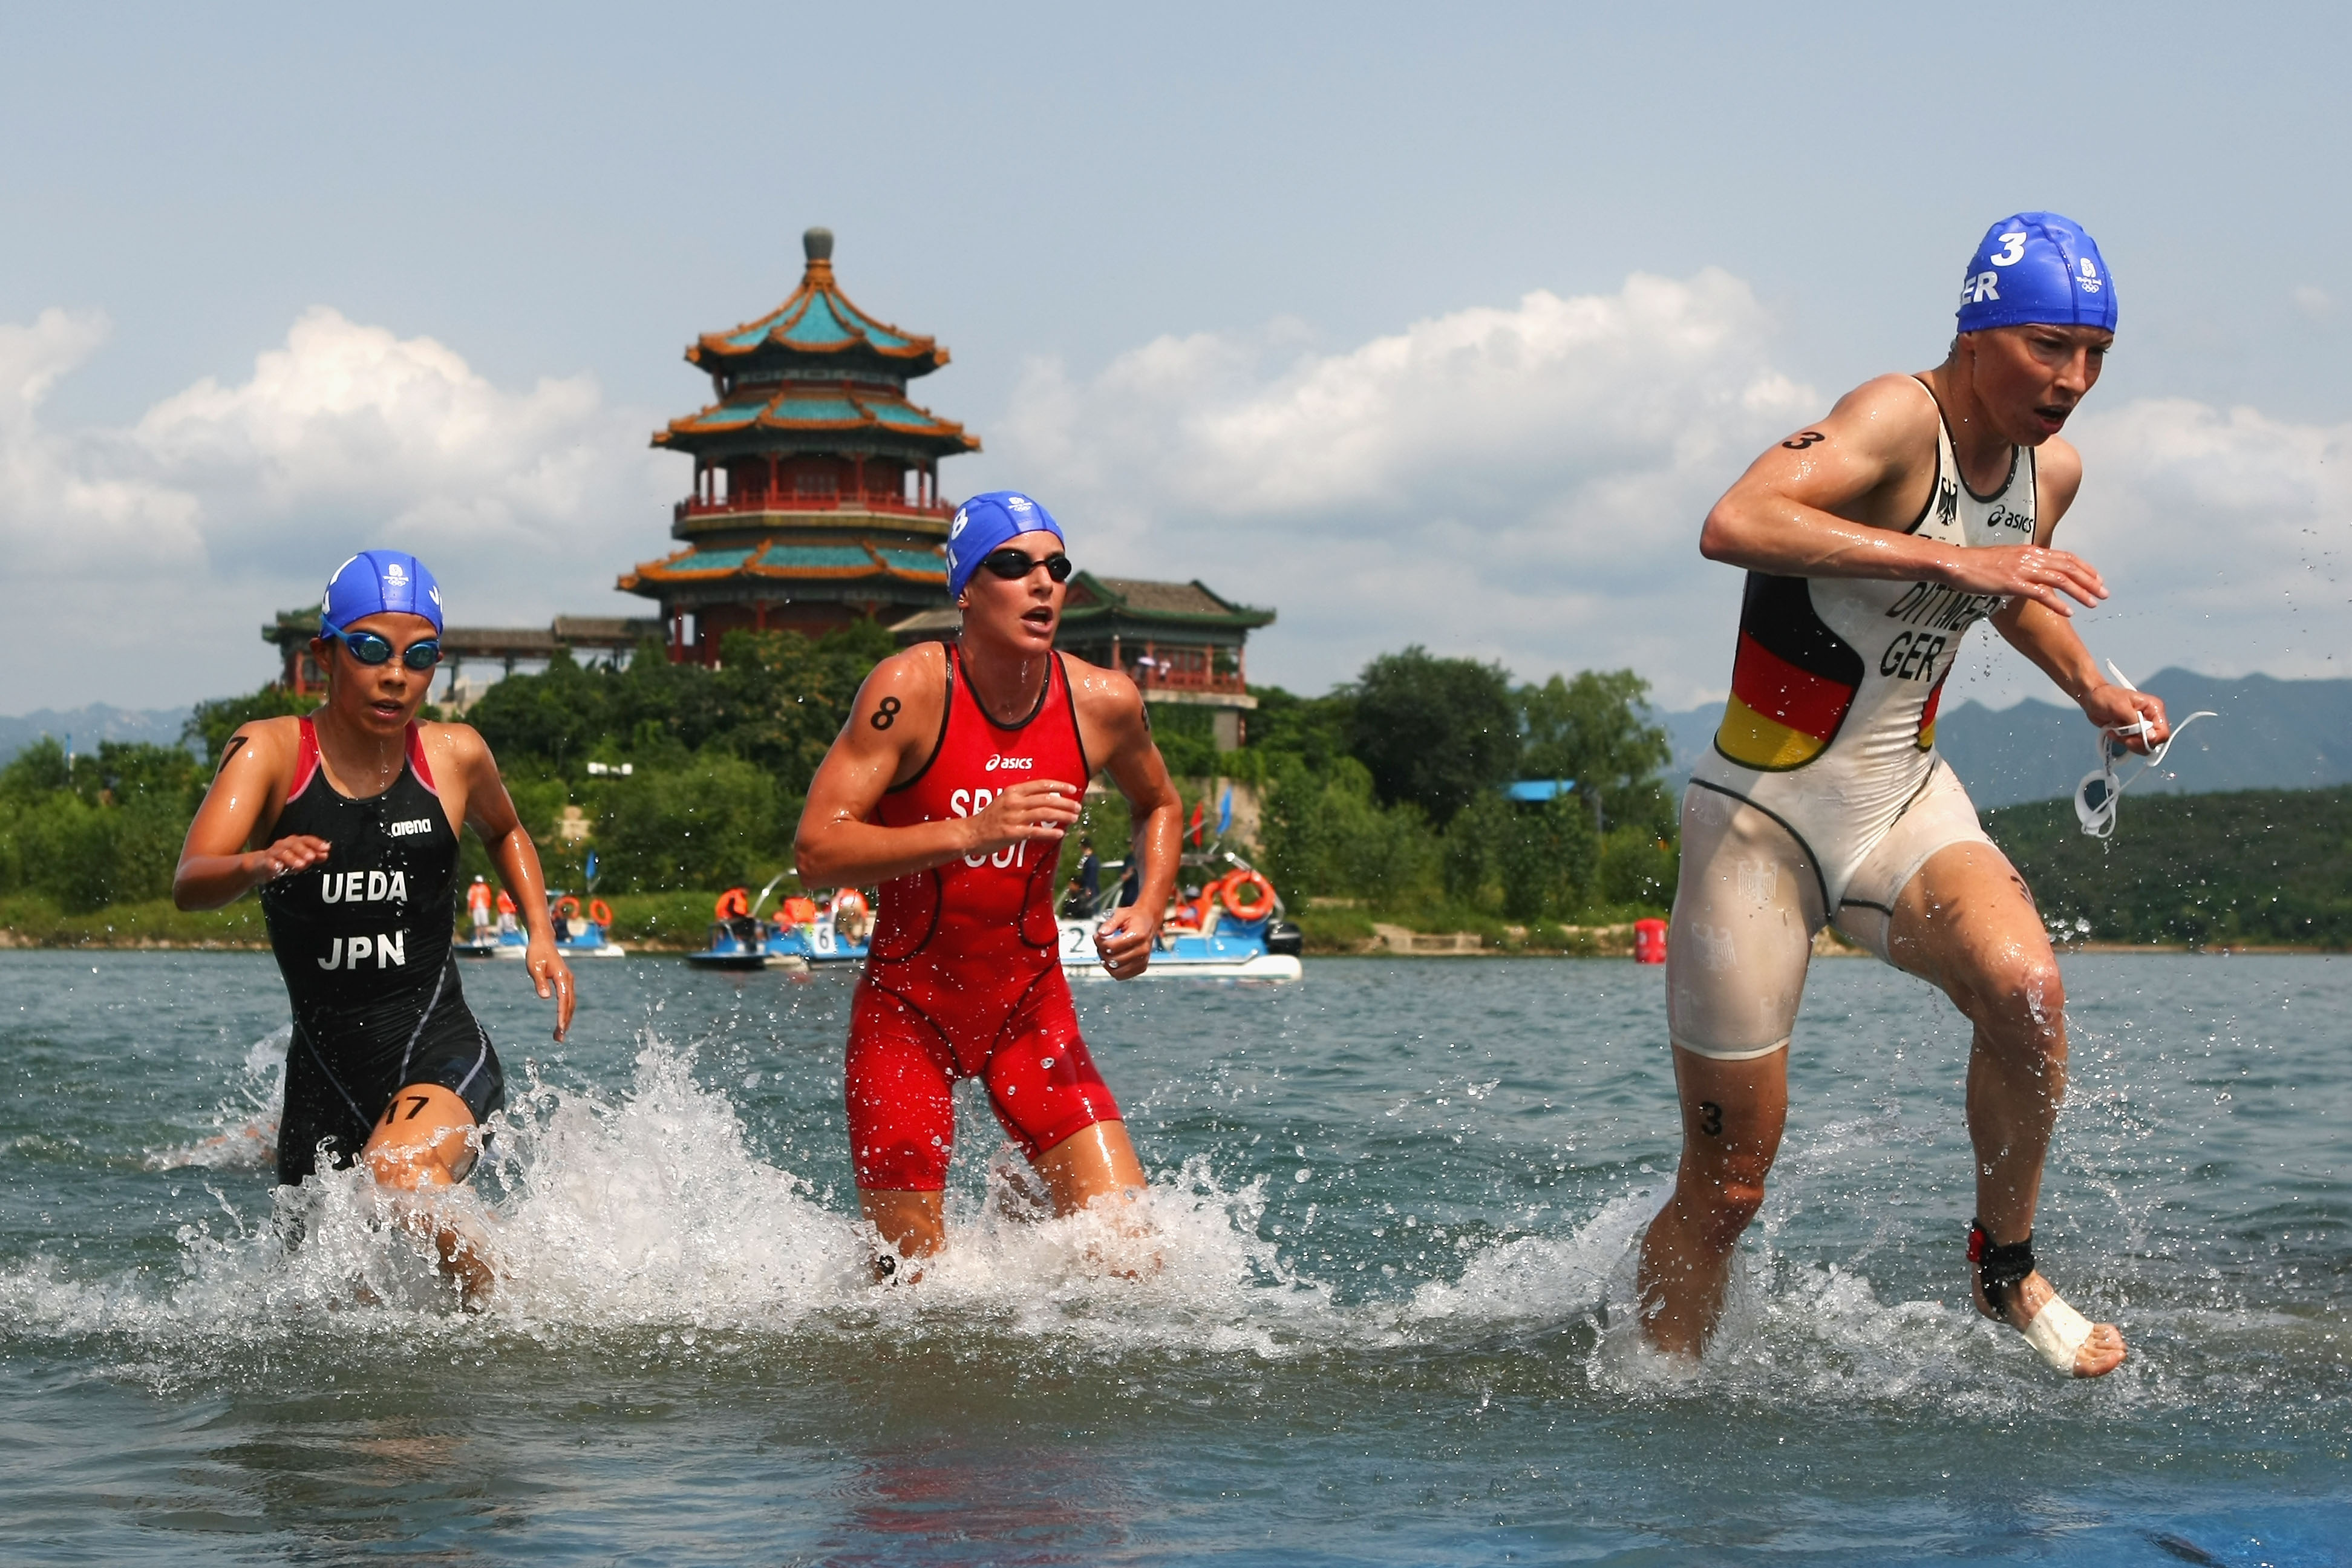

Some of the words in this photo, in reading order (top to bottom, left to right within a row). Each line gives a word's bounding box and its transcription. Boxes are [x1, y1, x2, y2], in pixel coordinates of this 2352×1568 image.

[1990, 232, 2027, 266] 3
[1782, 431, 1825, 449] 3
[951, 508, 969, 540] 8
[2005, 512, 2033, 533] asics
[1880, 631, 1946, 682] GER
[871, 696, 901, 731] 8
[1001, 758, 1033, 769] asics
[391, 818, 432, 837] arena
[322, 871, 408, 904] UEDA
[317, 930, 406, 970] JPN
[818, 927, 829, 950] 6
[1069, 927, 1085, 953] 2
[385, 1096, 430, 1125] 17
[1699, 1102, 1722, 1136] 3
